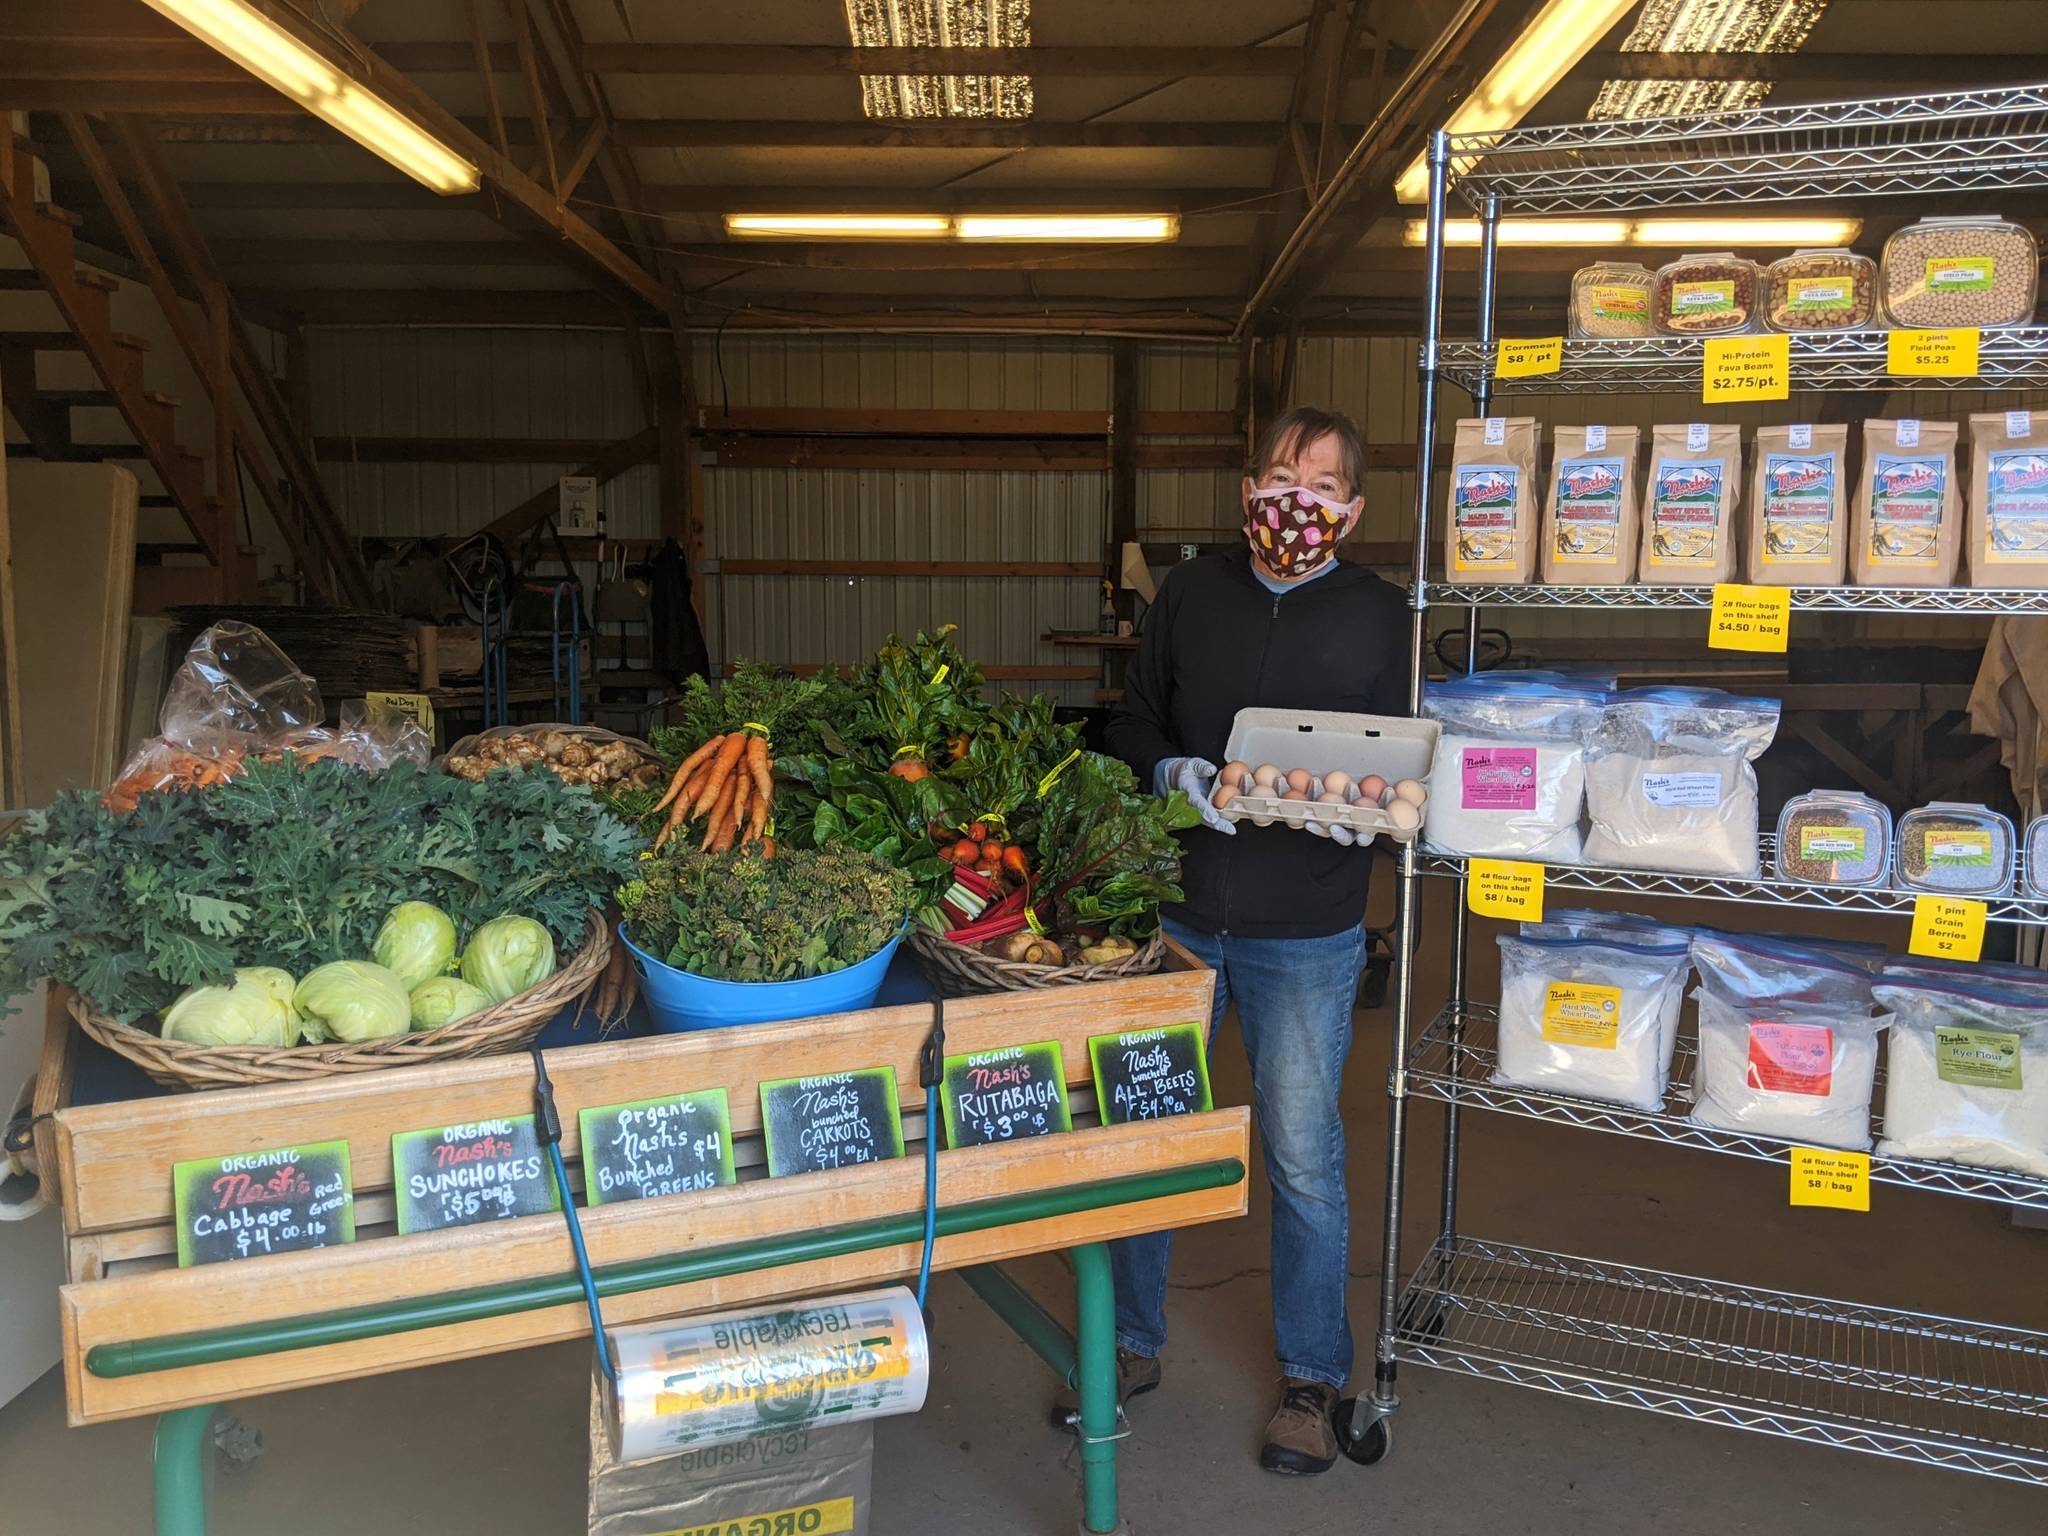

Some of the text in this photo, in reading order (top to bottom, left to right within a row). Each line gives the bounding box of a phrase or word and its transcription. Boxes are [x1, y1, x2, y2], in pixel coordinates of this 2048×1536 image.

[1926, 334, 1949, 342] pints
[1505, 342, 1556, 351] Cornmeal
[1507, 355, 1524, 363] $8
[1536, 352, 1552, 363] pt
[1722, 350, 1770, 360] Hi-Protein
[1916, 355, 1949, 364] $5.25
[1744, 363, 1773, 371] Beans
[1713, 376, 1778, 389] $2.75/pt.
[1759, 602, 1780, 610] bags
[1719, 622, 1749, 632] $4.50
[1759, 624, 1780, 635] bag
[1513, 875, 1532, 883] bags
[1485, 893, 1498, 901] $8
[1506, 895, 1525, 906] bag
[1945, 907, 1966, 916] pint
[1935, 917, 1964, 928] Grain
[1928, 928, 1967, 940] Berries
[1938, 941, 1953, 950] $2
[1119, 1029, 1166, 1046] ORGANIC
[1937, 1033, 1968, 1042] Nash's
[968, 1047, 1024, 1067] ORGANIC
[1122, 1045, 1172, 1072] Nash's
[1952, 1048, 2003, 1061] Rye Flour
[799, 1073, 854, 1090] ORGANIC
[1154, 1070, 1196, 1095] BEETS
[793, 1086, 859, 1116] Nash's
[959, 1080, 1060, 1122] RUTABAGA
[618, 1096, 696, 1131] Organic
[443, 1119, 513, 1144] ORGANIC
[800, 1117, 871, 1148] CARROTS
[612, 1121, 688, 1160] Nash's
[694, 1131, 721, 1163] $4
[221, 1149, 301, 1173] ORGANIC
[1815, 1158, 1836, 1167] flour
[1838, 1161, 1859, 1169] bags
[410, 1156, 542, 1199] SUNCHOKES
[598, 1154, 674, 1191] Bunched
[1816, 1169, 1833, 1177] this
[1836, 1171, 1858, 1179] shelf
[314, 1172, 343, 1199] Red
[642, 1170, 716, 1199] GREENS
[1808, 1180, 1821, 1188] $8
[1831, 1181, 1853, 1193] bag
[309, 1193, 353, 1216] Green
[194, 1207, 292, 1237] Cabbage
